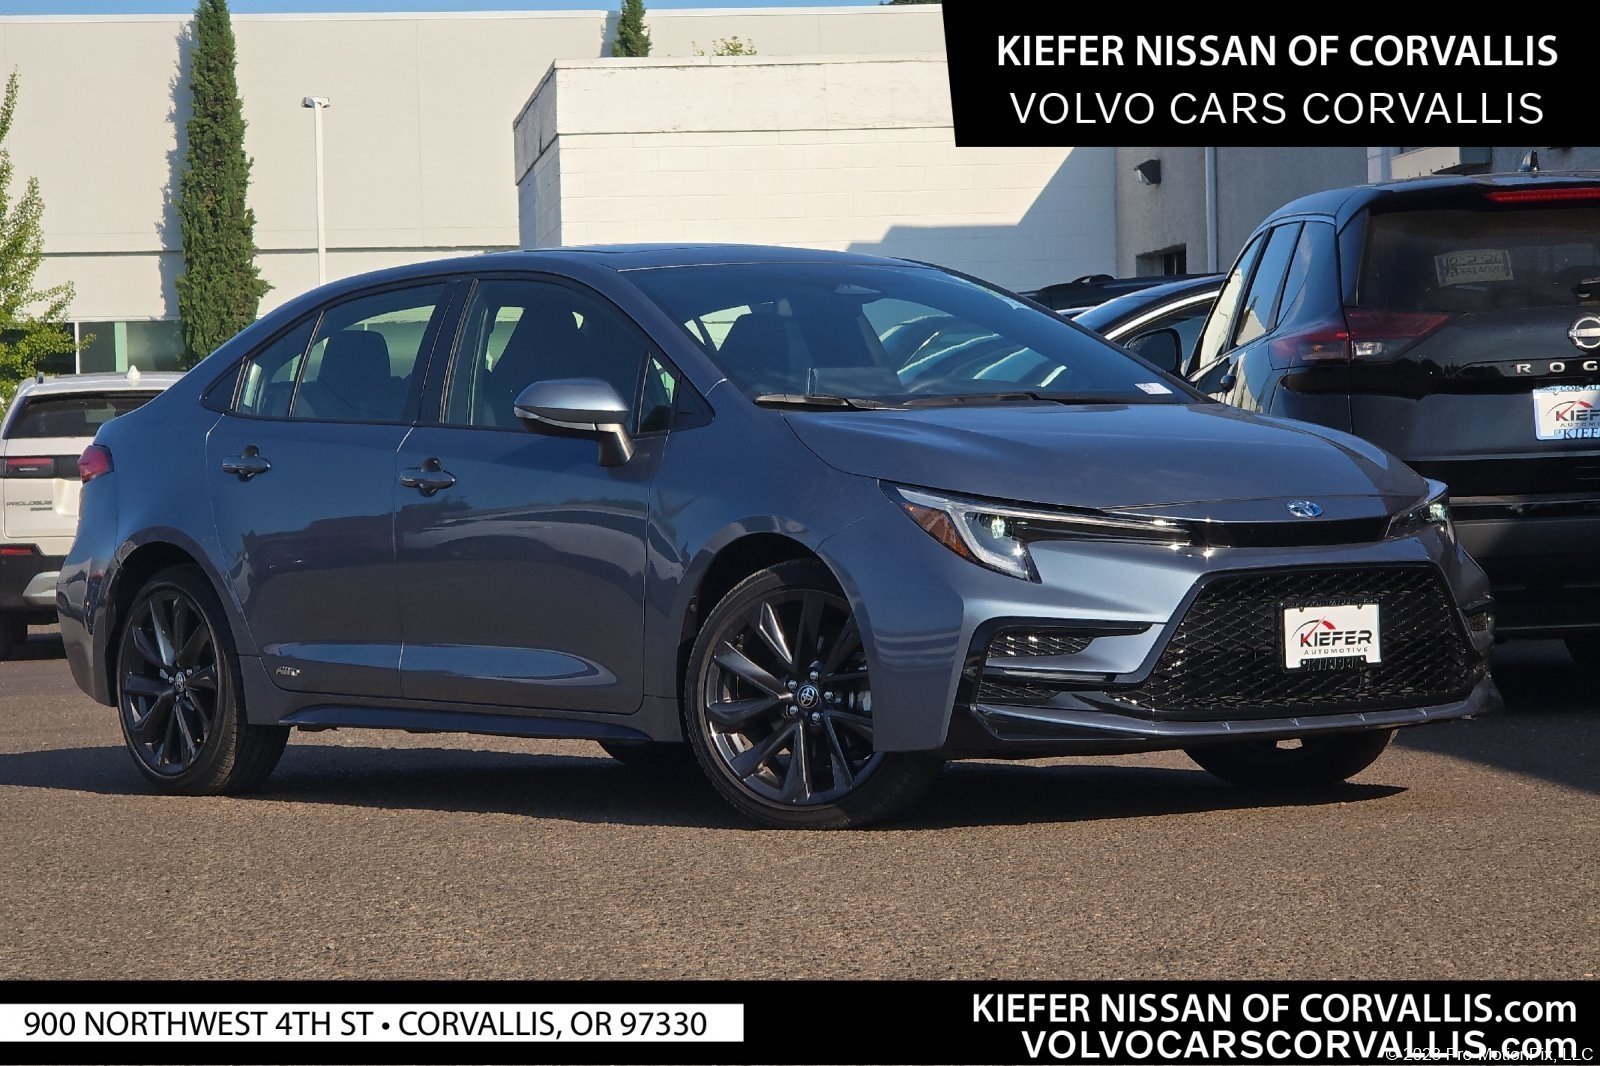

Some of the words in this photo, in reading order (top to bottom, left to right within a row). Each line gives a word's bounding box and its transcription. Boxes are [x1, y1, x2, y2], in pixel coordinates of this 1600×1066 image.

[1516, 360, 1598, 375] ROG
[1300, 629, 1373, 648] KIEFER
[1304, 646, 1368, 655] AUTOMOTIVE
